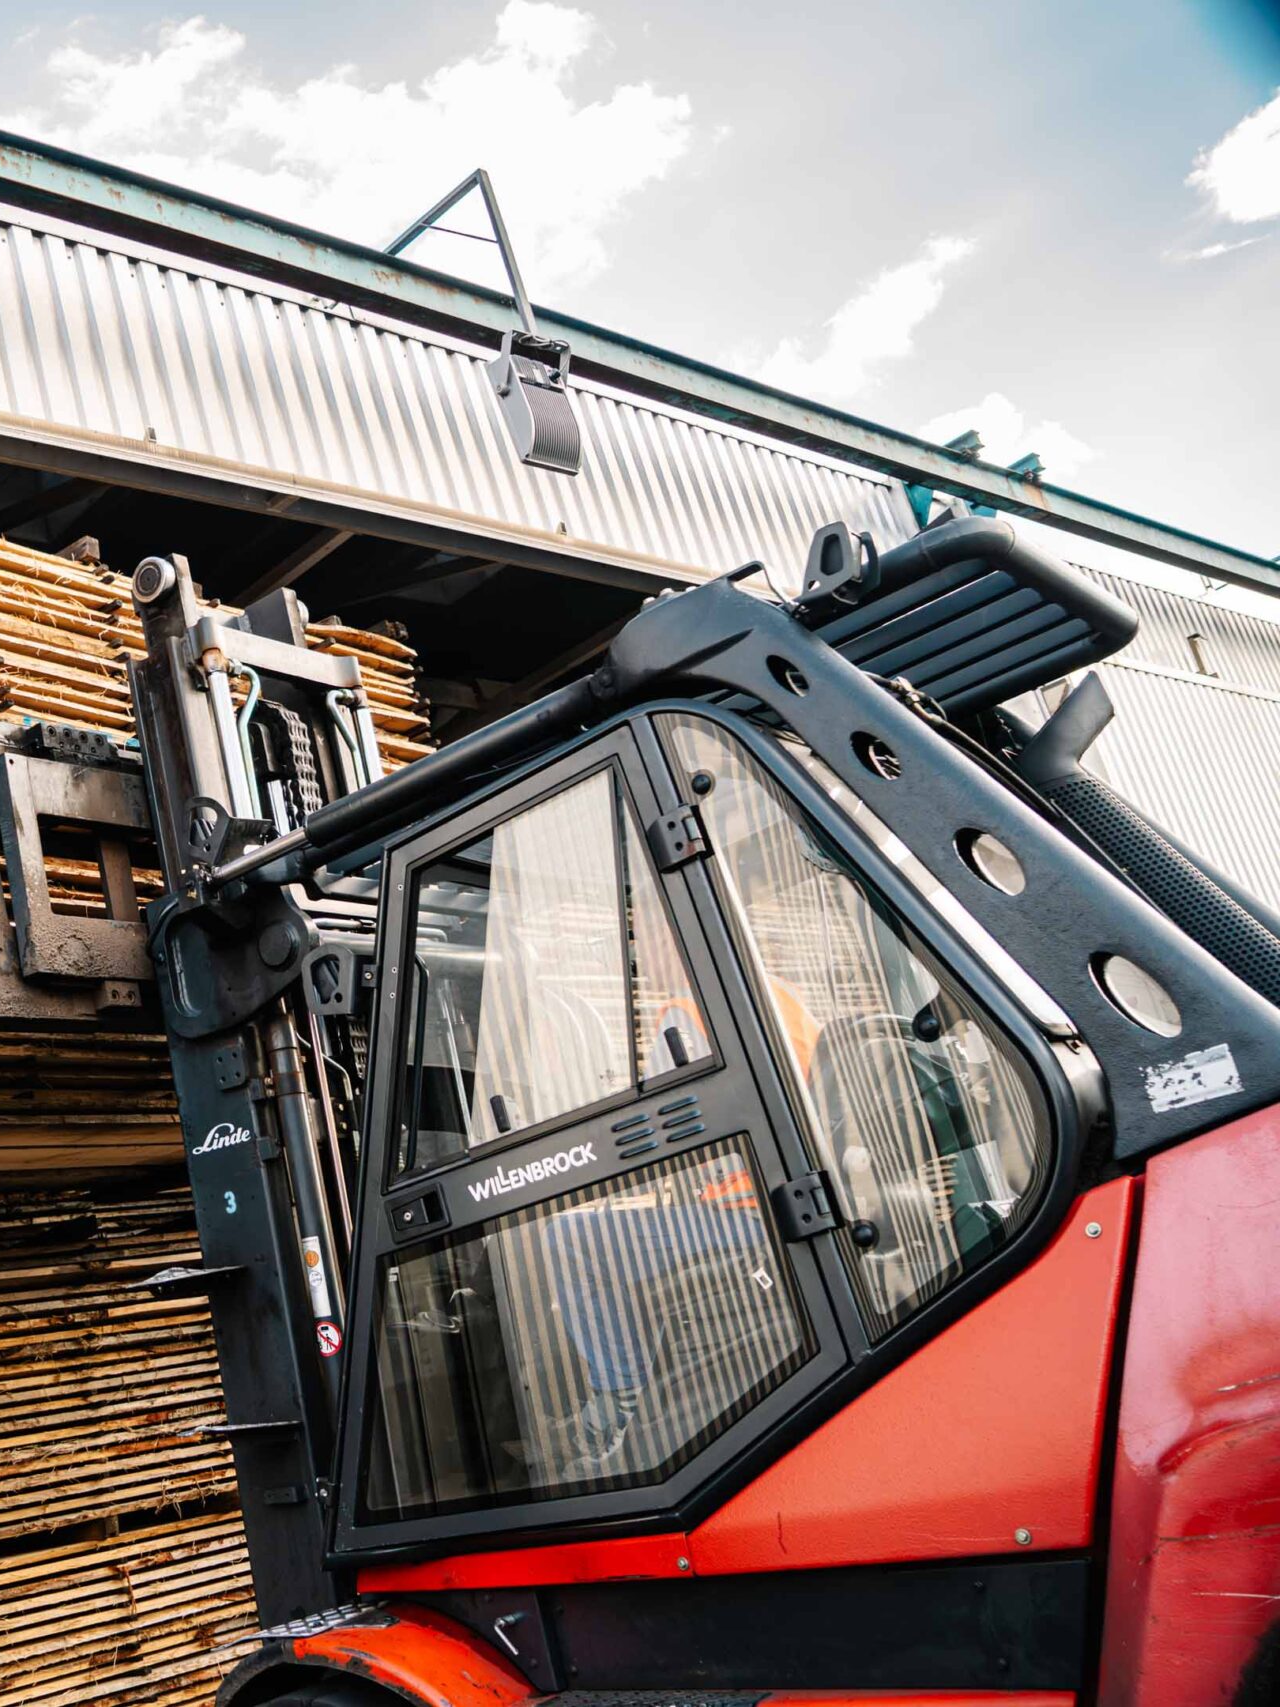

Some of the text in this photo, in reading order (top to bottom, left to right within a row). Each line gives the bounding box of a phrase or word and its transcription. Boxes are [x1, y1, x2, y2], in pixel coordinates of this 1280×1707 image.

[192, 1122, 252, 1156] Linde
[467, 1141, 597, 1203] WILLENBROCK
[223, 1191, 238, 1215] 3
